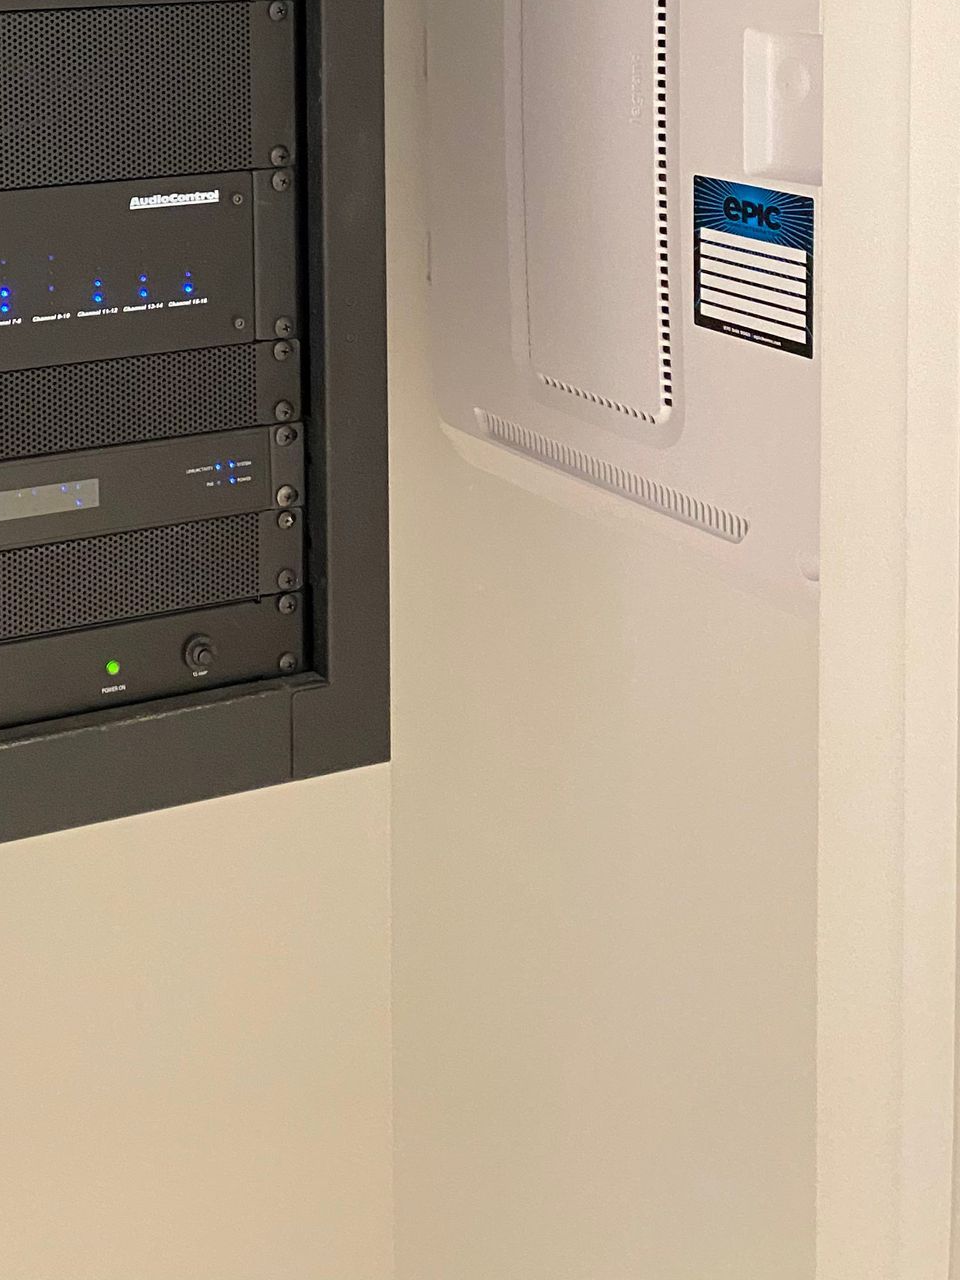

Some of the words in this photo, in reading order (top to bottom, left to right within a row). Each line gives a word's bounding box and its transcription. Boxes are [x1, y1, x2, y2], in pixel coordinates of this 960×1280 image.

[130, 189, 220, 208] AudioControl
[122, 304, 146, 312] Channel
[168, 300, 191, 308] Channel
[77, 309, 101, 318] Channel
[32, 314, 56, 322] Channel
[101, 685, 118, 694] POWER
